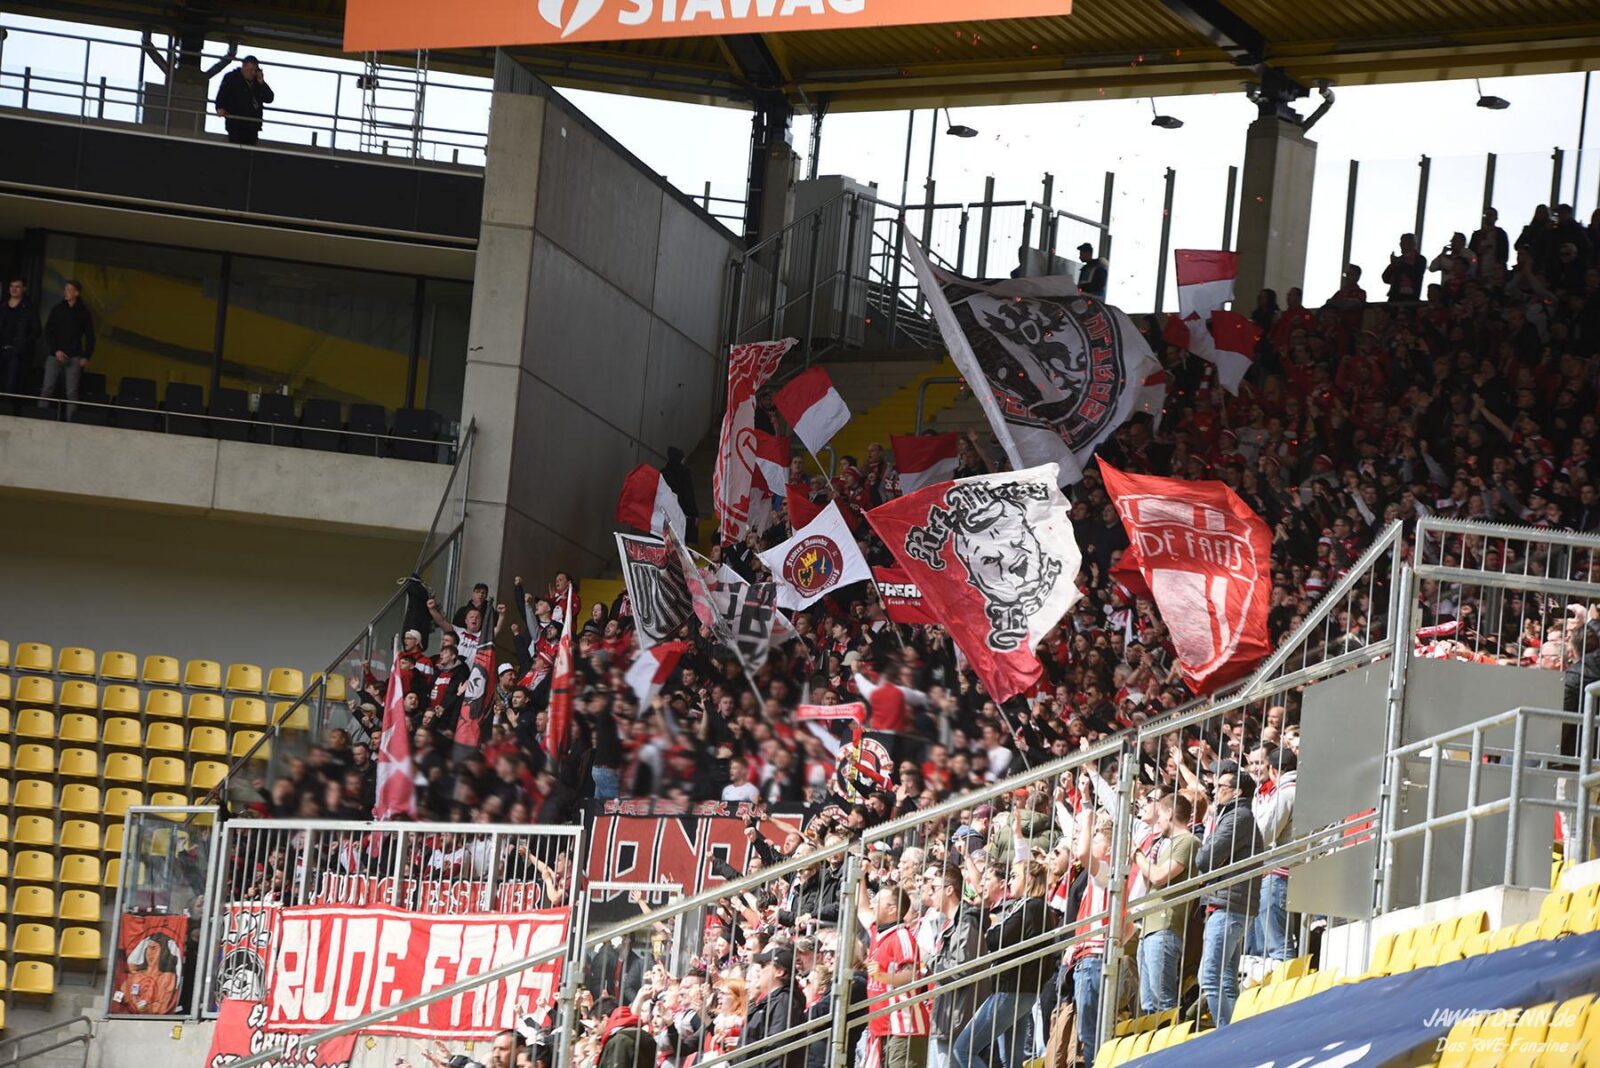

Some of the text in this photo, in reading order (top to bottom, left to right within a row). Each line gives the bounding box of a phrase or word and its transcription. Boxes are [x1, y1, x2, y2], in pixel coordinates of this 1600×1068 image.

[1184, 531, 1242, 571] FANS
[271, 917, 565, 1030] RUDE FANS
